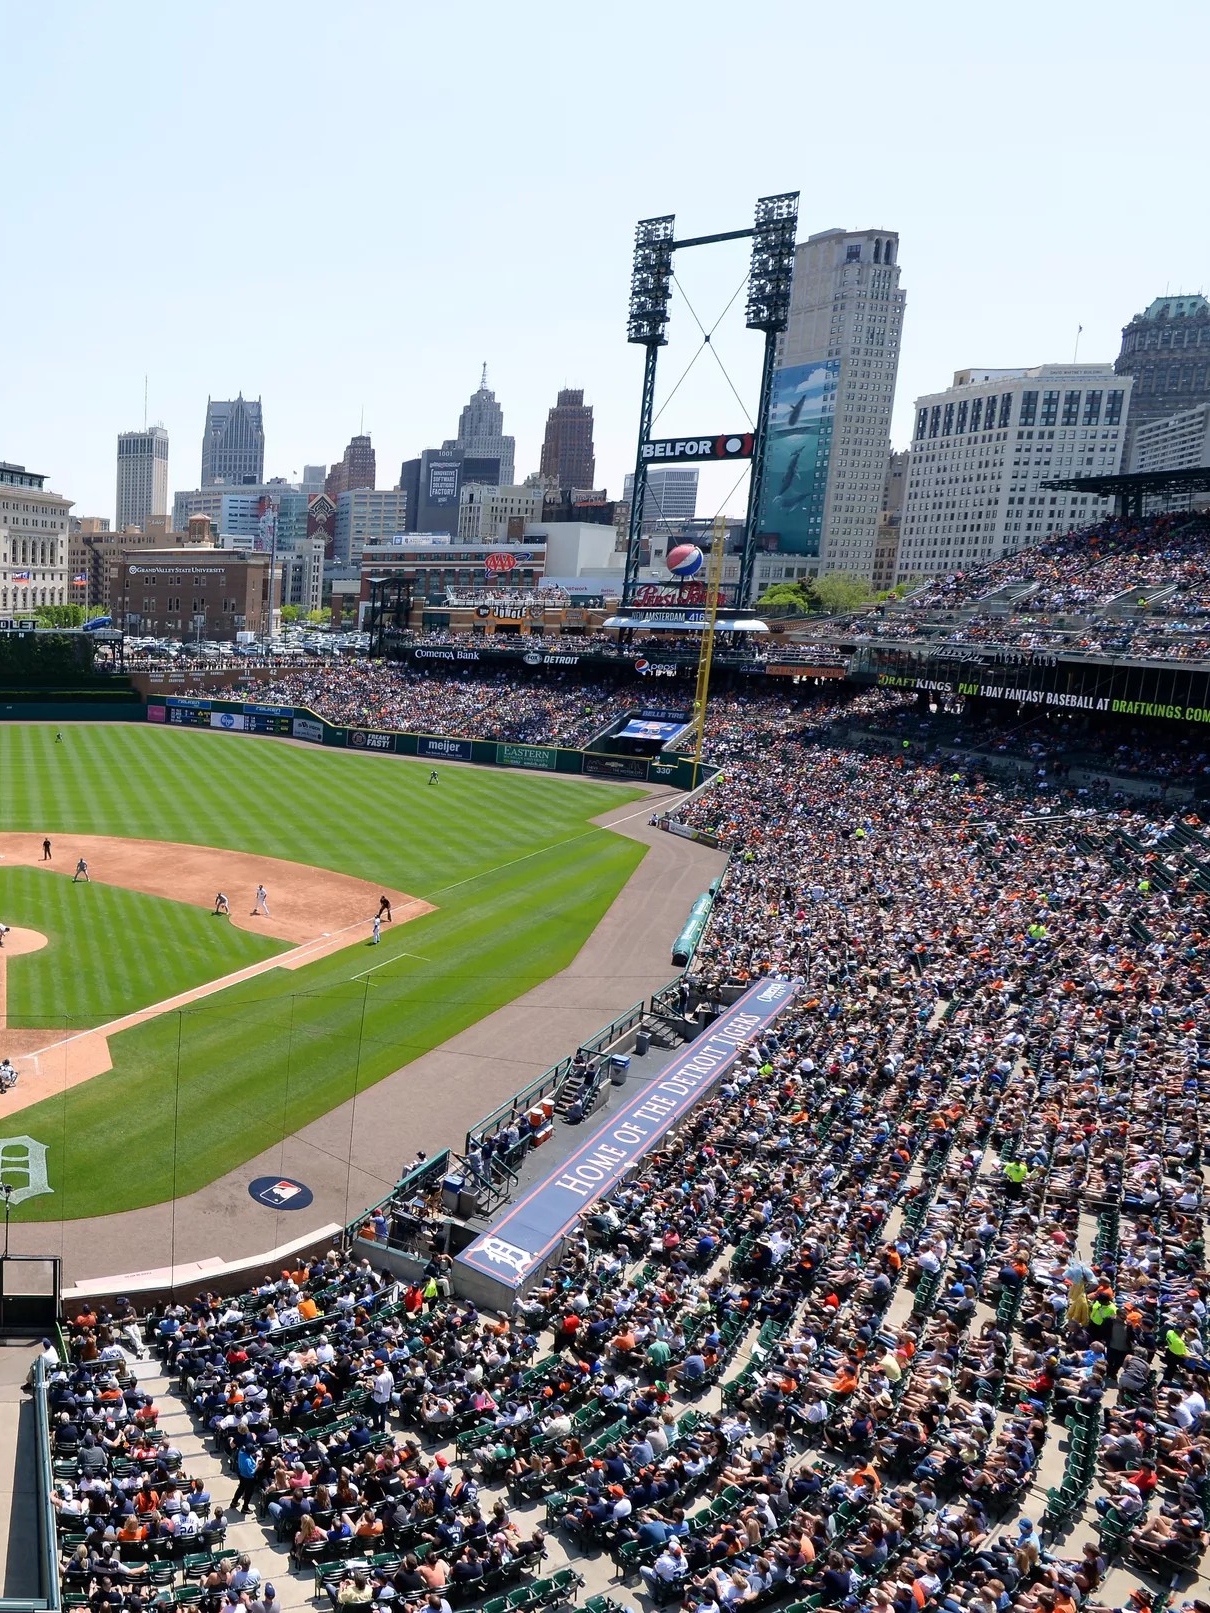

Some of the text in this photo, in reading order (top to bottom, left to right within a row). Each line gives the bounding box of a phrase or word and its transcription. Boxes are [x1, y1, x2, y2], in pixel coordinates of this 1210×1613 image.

[642, 440, 711, 458] BELFOR
[487, 553, 515, 571] AAA
[493, 606, 527, 619] JUNGLE
[645, 612, 685, 622] AMSTERDAM
[689, 613, 705, 621] 416
[457, 651, 480, 660] Bank
[543, 655, 580, 665] DETROIT
[993, 652, 1022, 665] TIGER
[1032, 655, 1059, 668] CLUB
[651, 662, 677, 672] pepsi
[880, 673, 952, 692] DRAFTKINGS
[958, 683, 979, 695] PLAY
[980, 685, 1004, 699] 1-DAY
[1004, 687, 1045, 703] FANTASY
[1046, 692, 1094, 710] BASEBALL
[1096, 698, 1111, 711] AT
[642, 711, 667, 719] BELLE
[367, 734, 390, 742] FREAKY
[366, 739, 390, 748] FAST!
[428, 740, 461, 752] meijer
[504, 745, 550, 759] EASTERN
[656, 767, 672, 775] 330'
[555, 1012, 762, 1197] HOME OF THE DETROIT TIGERS
[180, 1525, 194, 1535] 24
[452, 1533, 460, 1544] 3
